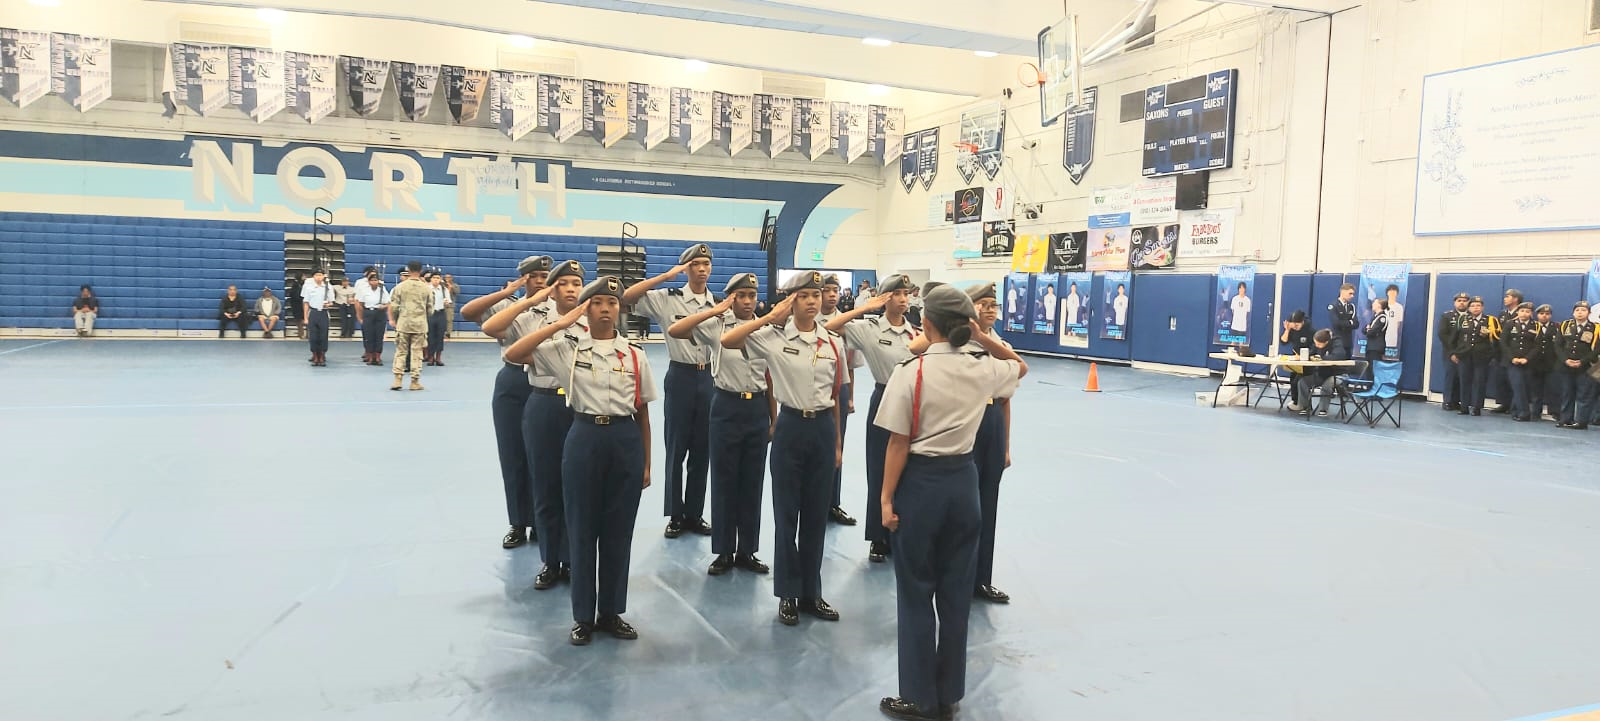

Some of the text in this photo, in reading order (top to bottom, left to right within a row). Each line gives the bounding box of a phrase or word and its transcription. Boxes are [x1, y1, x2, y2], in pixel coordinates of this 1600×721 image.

[351, 57, 388, 69] NORTH
[402, 63, 438, 74] NORTH
[452, 67, 488, 77] NORTH
[1203, 96, 1226, 109] GUEST
[1145, 108, 1169, 121] SAXONS
[1210, 131, 1225, 140] FOULS
[1169, 136, 1198, 146] PLAYER FOUL
[1144, 142, 1157, 151] FOULS
[1173, 163, 1190, 171] MATCH
[188, 138, 567, 220] NORTH
[1192, 237, 1218, 245] BURGERS
